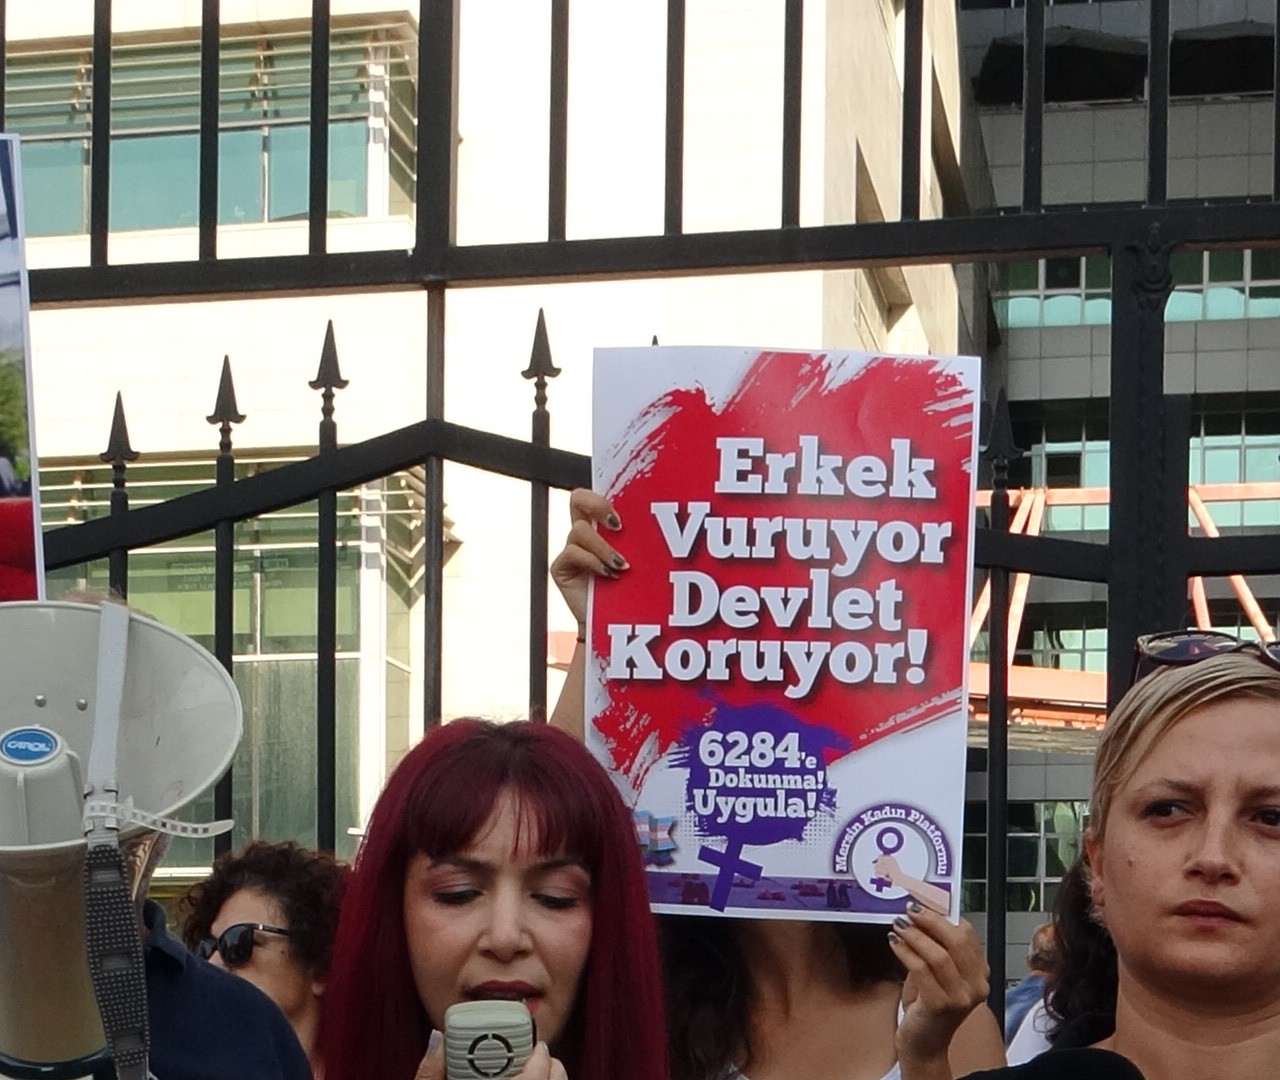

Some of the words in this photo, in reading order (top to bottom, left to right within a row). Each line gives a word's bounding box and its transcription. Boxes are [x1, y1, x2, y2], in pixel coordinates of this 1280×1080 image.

[714, 435, 937, 499] Erkek
[651, 502, 952, 577] Vuruyor
[668, 569, 902, 630] Devlet
[606, 624, 928, 699] Koruyor!
[698, 730, 818, 769] 6284'e
[708, 767, 825, 790] Dokunma!
[692, 788, 817, 824] Uygula!
[835, 821, 864, 872] Mersin
[860, 806, 906, 826] Kadın
[907, 809, 948, 875] Platformu
